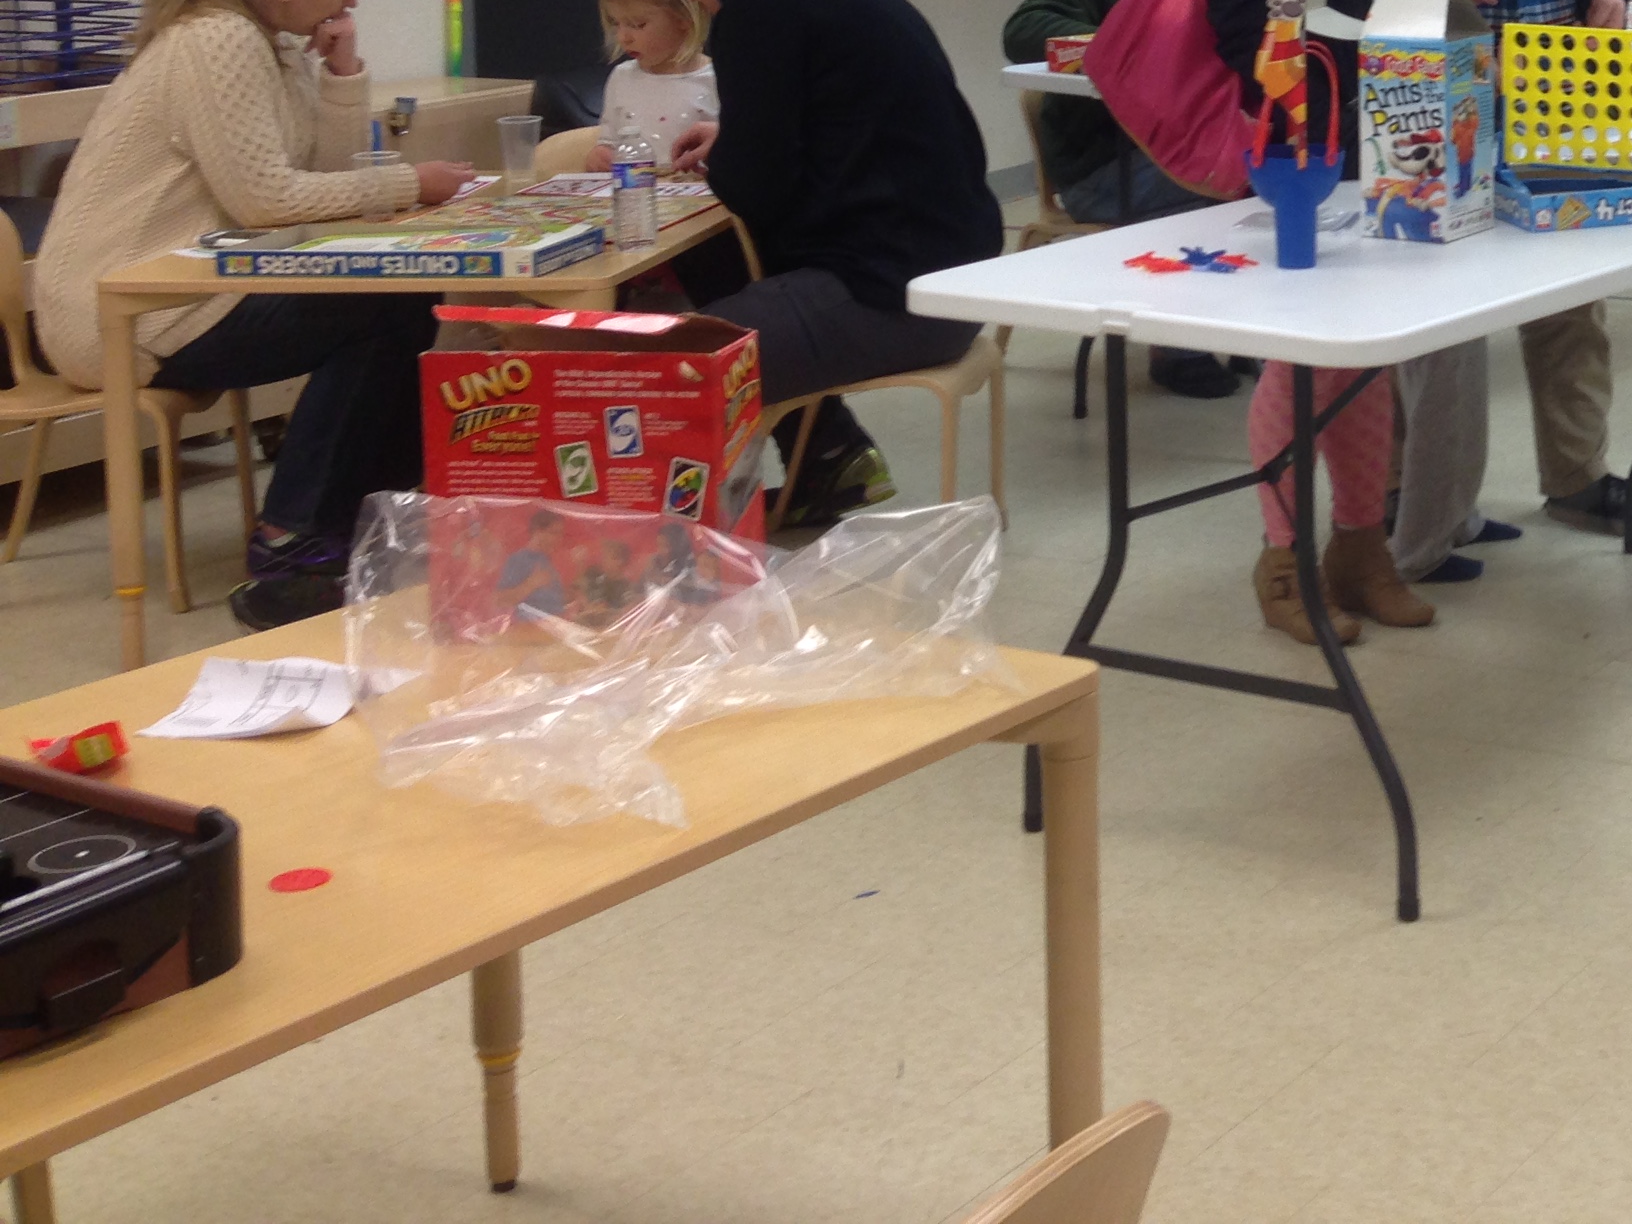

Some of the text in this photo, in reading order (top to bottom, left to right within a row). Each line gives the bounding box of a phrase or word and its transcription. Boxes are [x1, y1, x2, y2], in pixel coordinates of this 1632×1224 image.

[1364, 81, 1423, 110] Ants
[1369, 106, 1444, 137] Pants
[1595, 197, 1615, 221] 4
[256, 254, 349, 275] LADDERS
[380, 255, 461, 275] CHUTES
[440, 358, 533, 411] UNO
